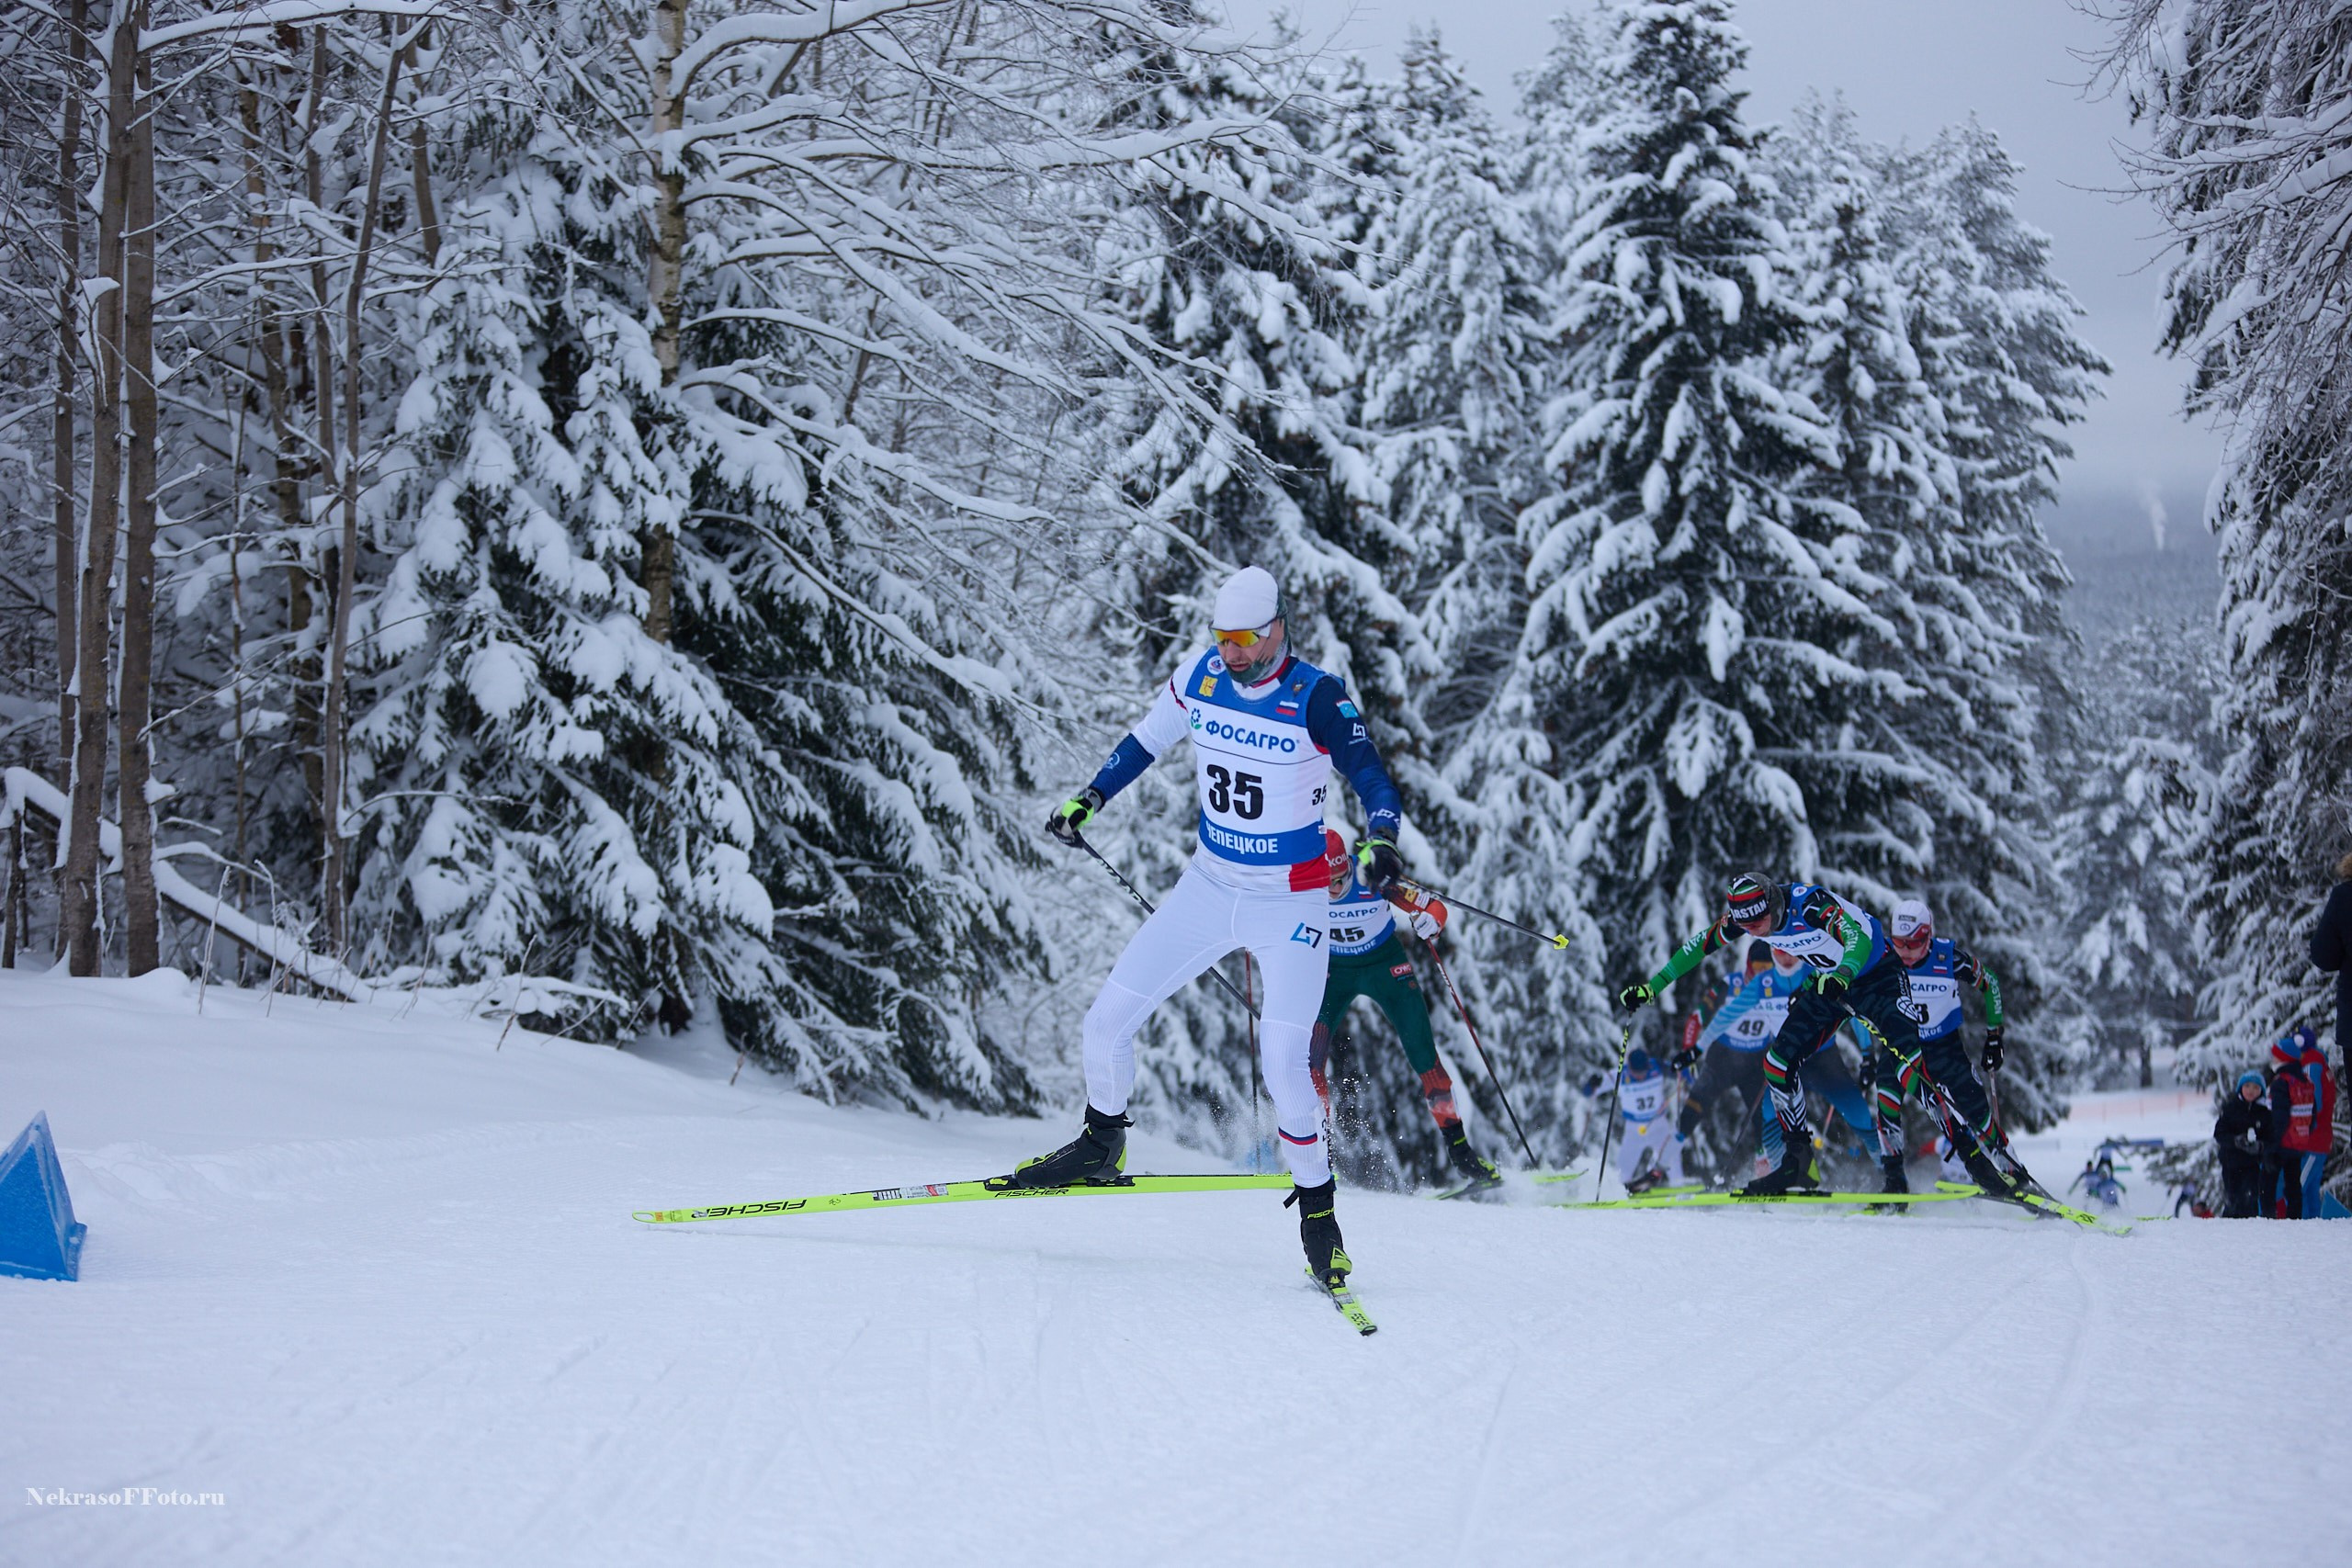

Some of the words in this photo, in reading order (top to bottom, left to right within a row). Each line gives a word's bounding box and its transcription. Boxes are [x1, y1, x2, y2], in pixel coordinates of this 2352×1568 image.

[1205, 720, 1295, 752] ФОСАГРО
[1206, 763, 1264, 820] 35
[1205, 820, 1279, 855] ЧЕПЕЦКОЕ
[1329, 907, 1379, 919] ОСАГРО
[1329, 926, 1365, 943] 45
[1330, 939, 1377, 954] ЕПЕЦКОЕ
[1911, 983, 1947, 993] САГРО
[1738, 1020, 1764, 1037] 49
[994, 1189, 1069, 1199] FISCHER
[1307, 1207, 1335, 1220] FISCH
